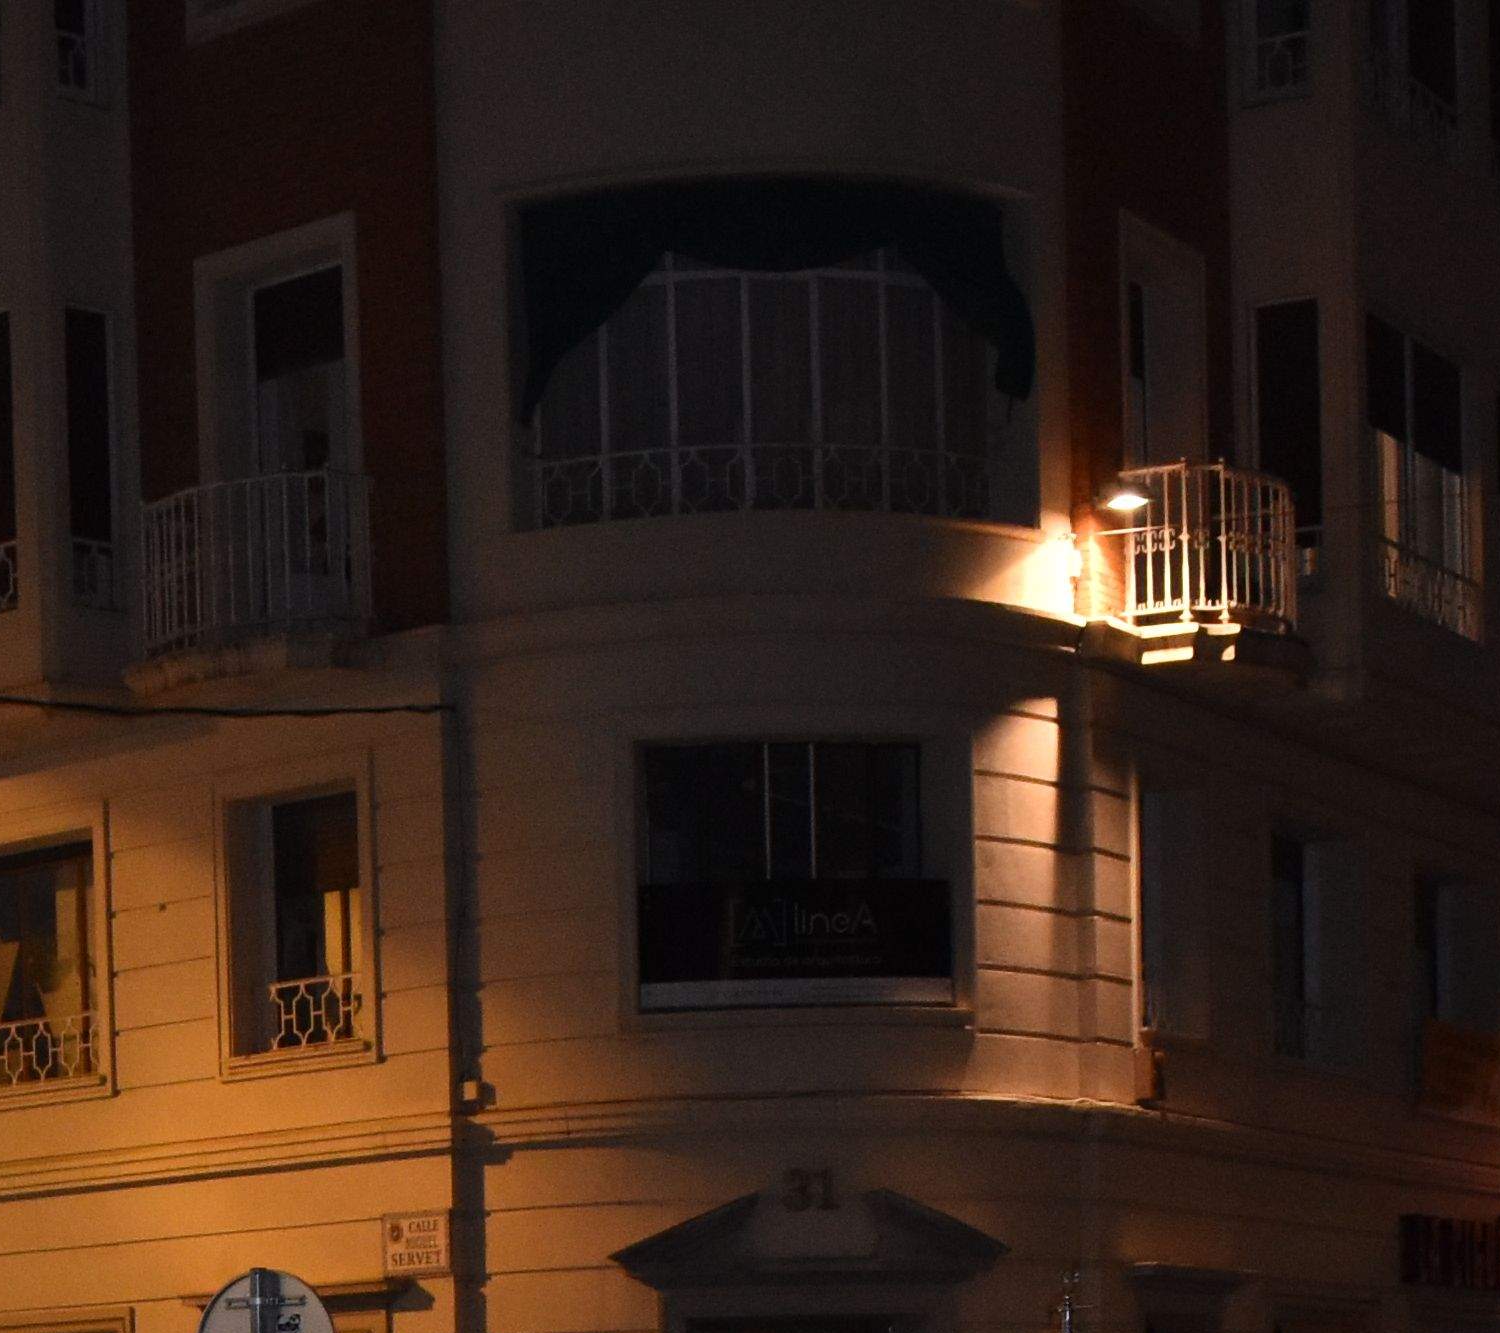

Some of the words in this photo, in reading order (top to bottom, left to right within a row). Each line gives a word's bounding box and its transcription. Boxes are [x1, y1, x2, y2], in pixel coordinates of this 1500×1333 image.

[783, 1167, 839, 1211] 31
[408, 1219, 440, 1233] CALLE
[391, 1249, 442, 1267] SERVET
